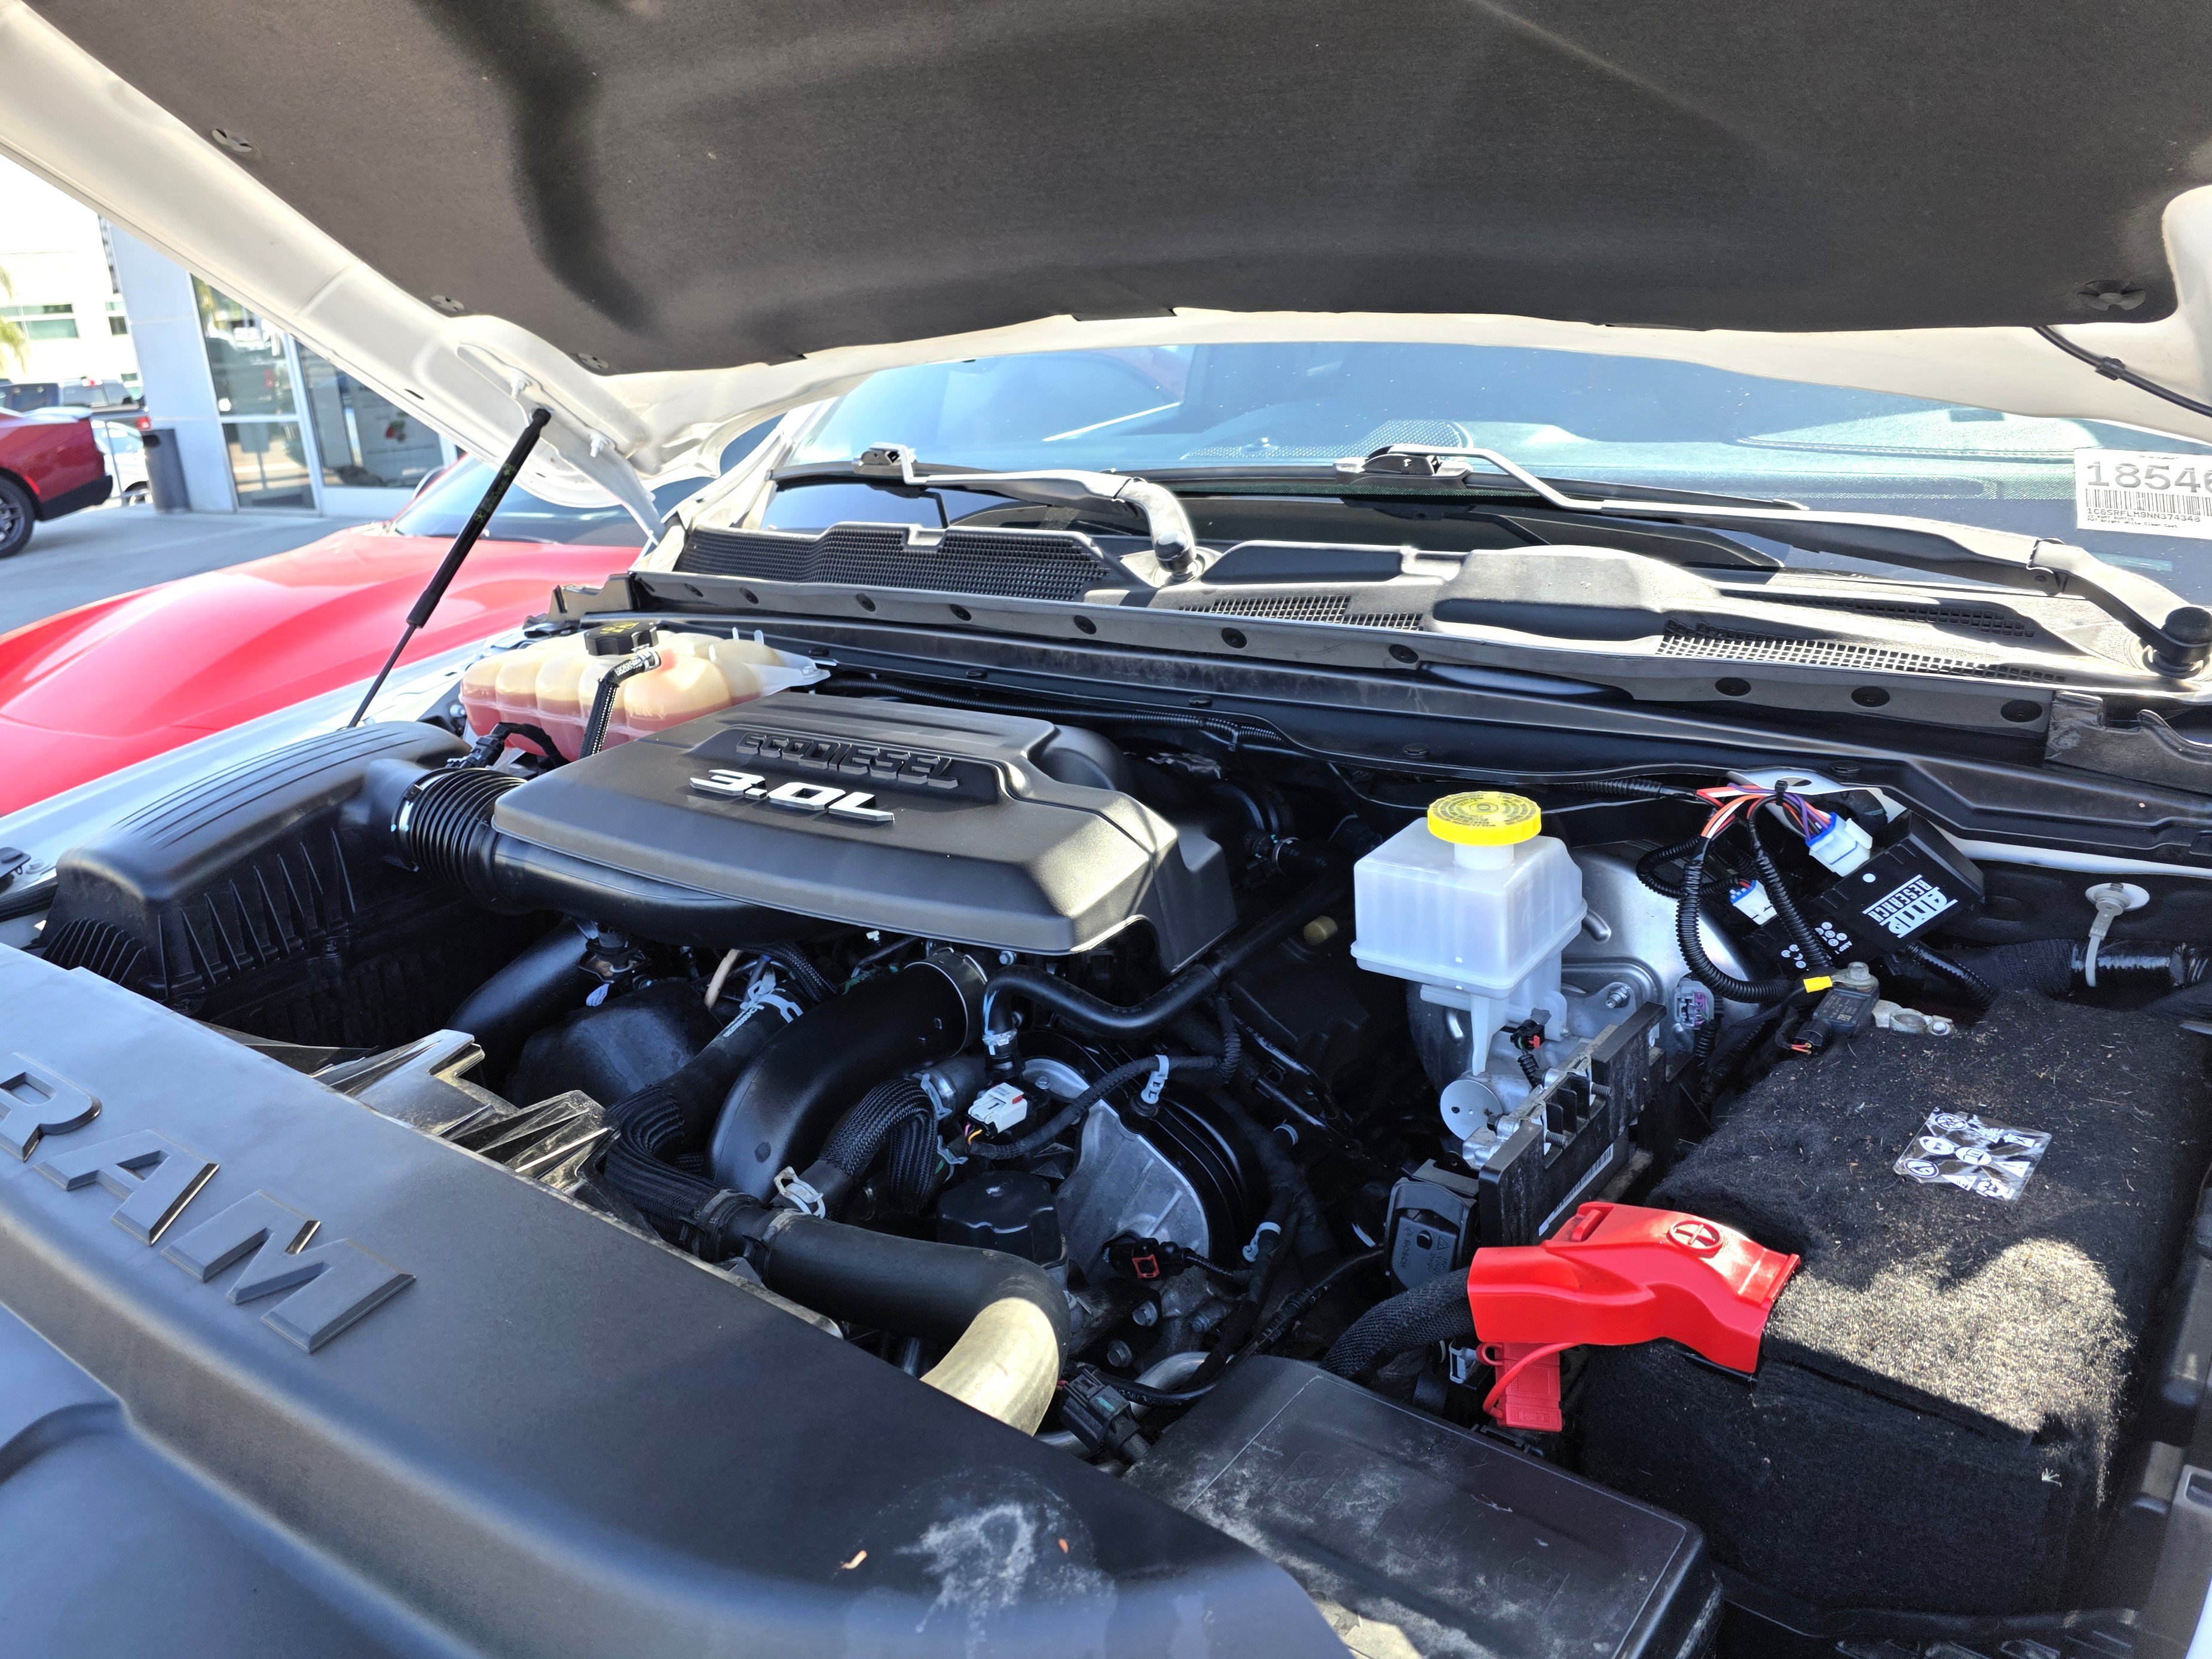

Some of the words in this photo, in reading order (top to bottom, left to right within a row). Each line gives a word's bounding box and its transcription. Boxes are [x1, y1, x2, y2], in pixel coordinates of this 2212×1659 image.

[736, 732, 959, 789] ECODIESEL
[690, 769, 895, 823] 3.0L
[1868, 879, 1933, 922] RESEARCH
[1883, 887, 1953, 937] AMP
[0, 1052, 416, 1354] RAM
[1399, 1239, 1411, 1269] BOSCH
